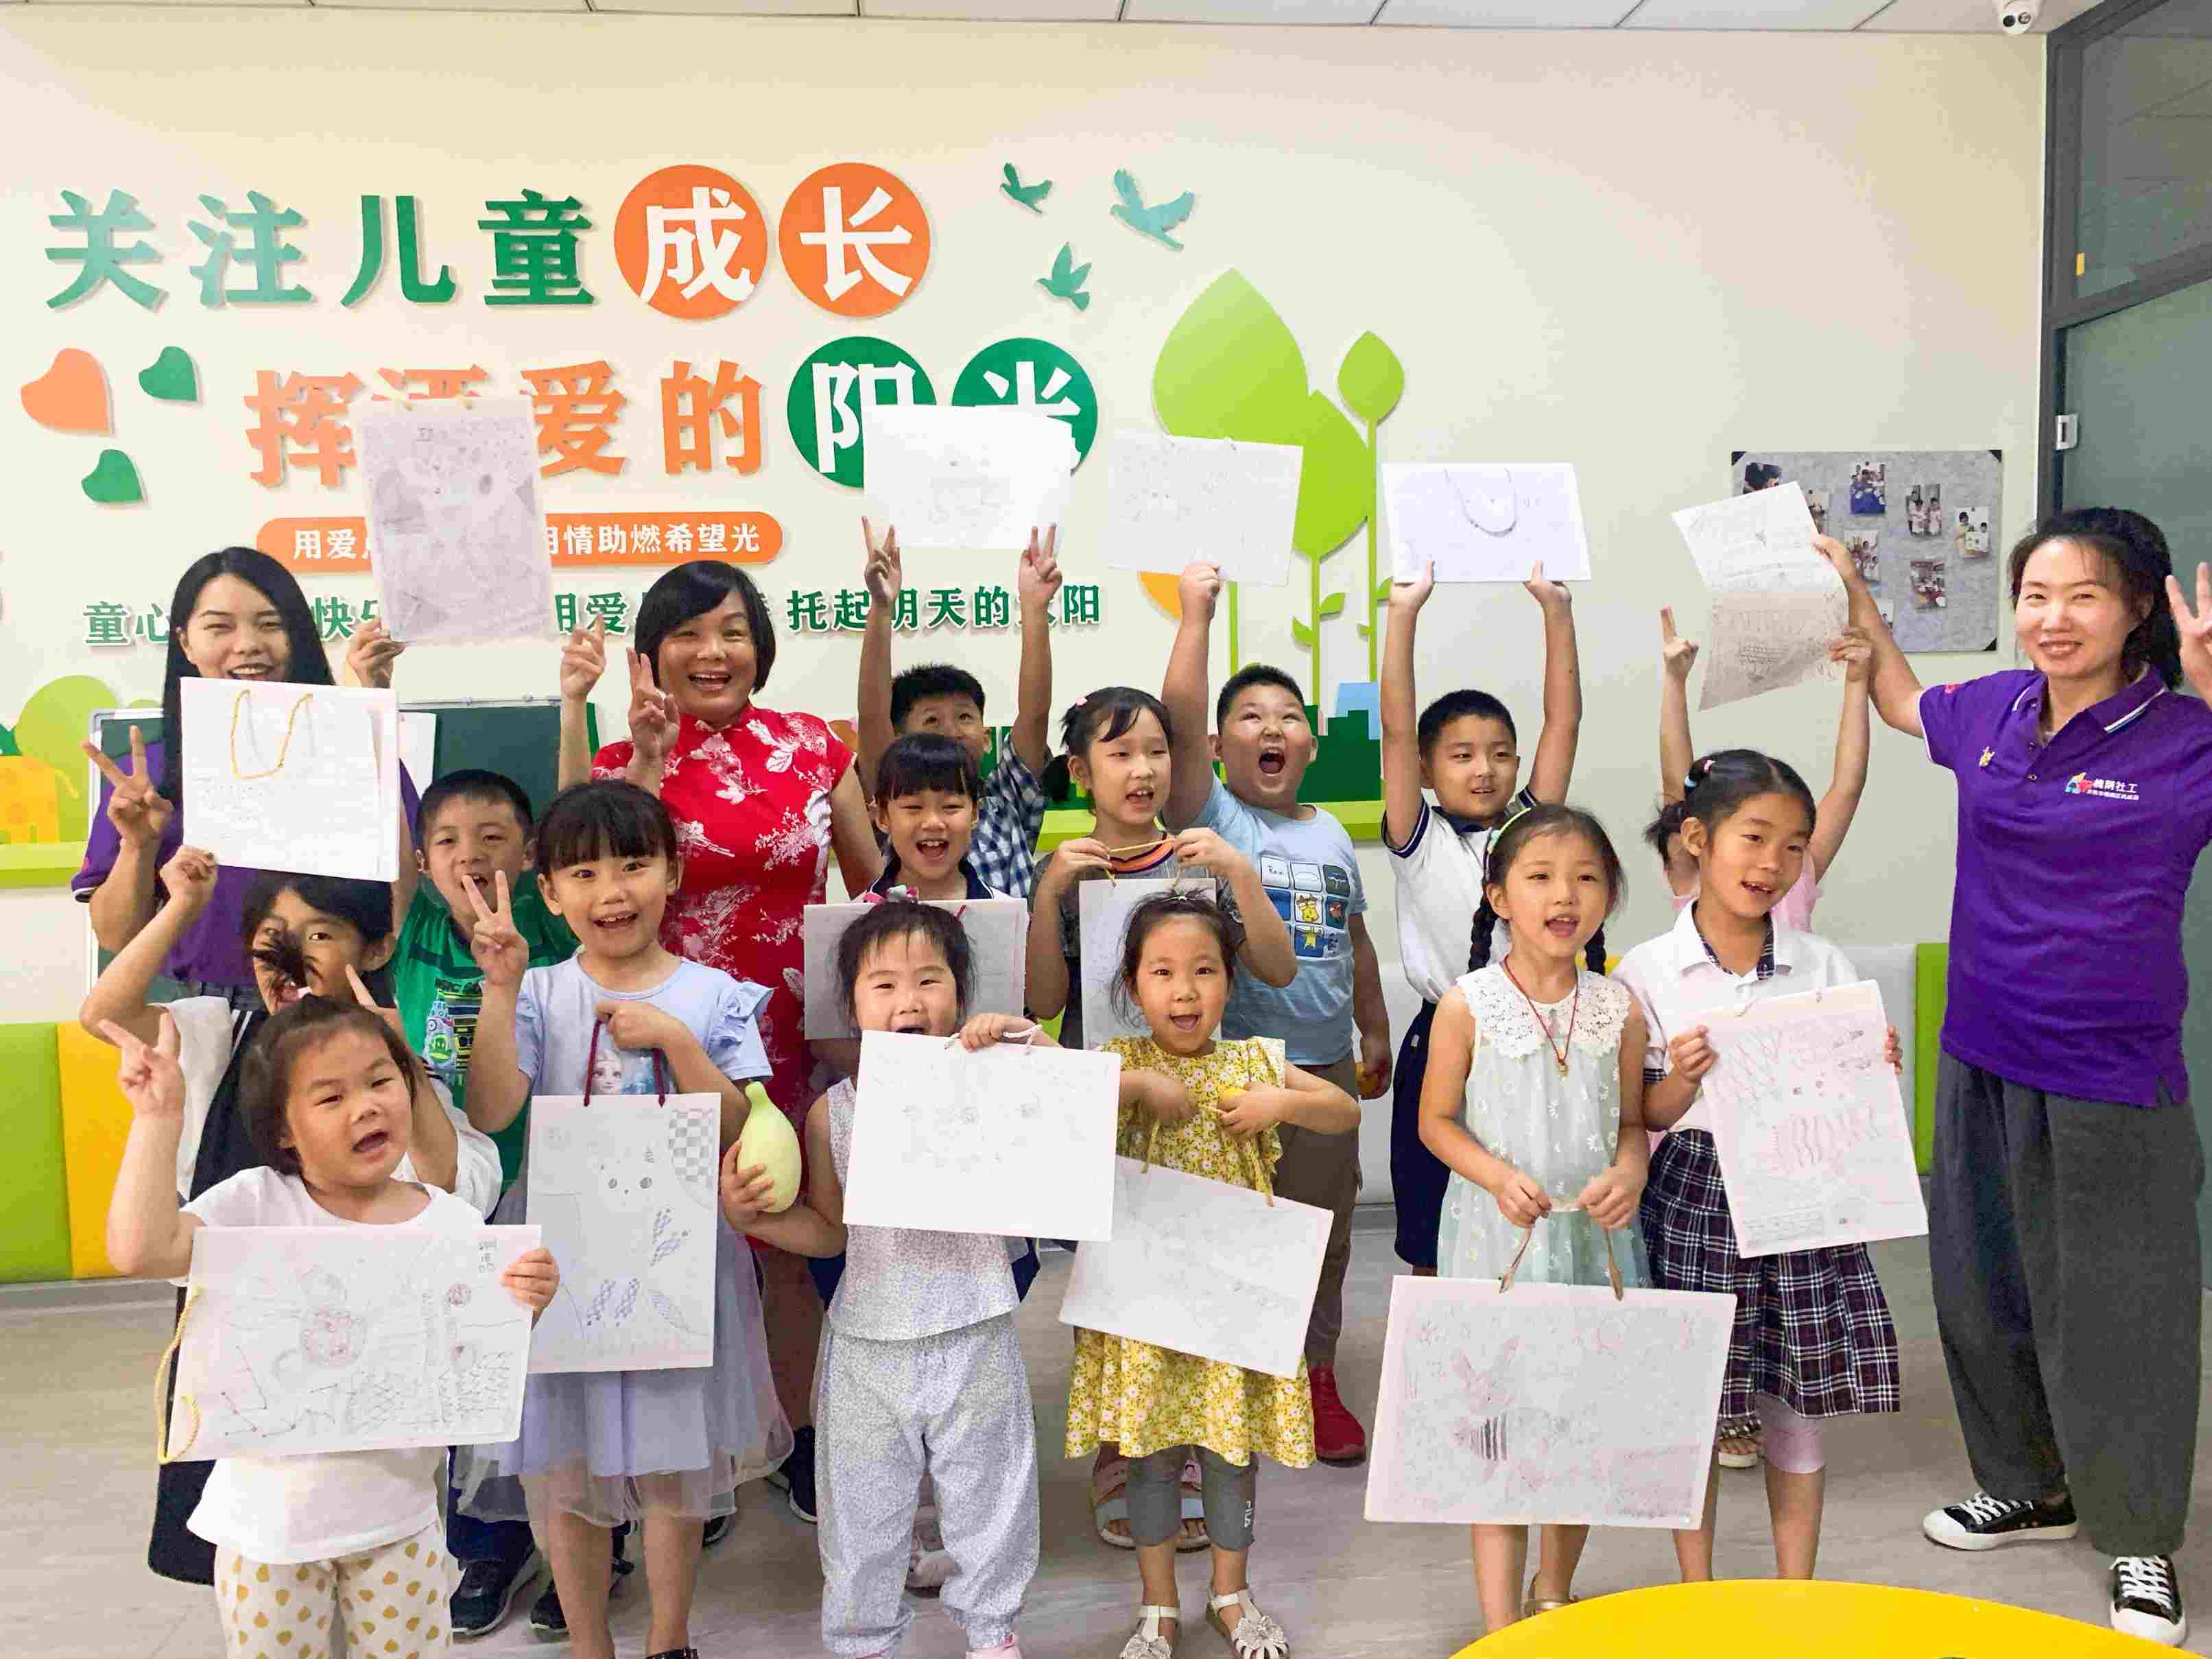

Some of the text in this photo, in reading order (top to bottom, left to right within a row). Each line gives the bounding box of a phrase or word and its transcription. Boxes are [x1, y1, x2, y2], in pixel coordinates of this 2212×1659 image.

[45, 186, 913, 309] 关注儿童成长
[243, 359, 1082, 487] 挥爱的阳
[294, 528, 373, 560] 用爱
[788, 584, 1101, 631] 托起明天的阳
